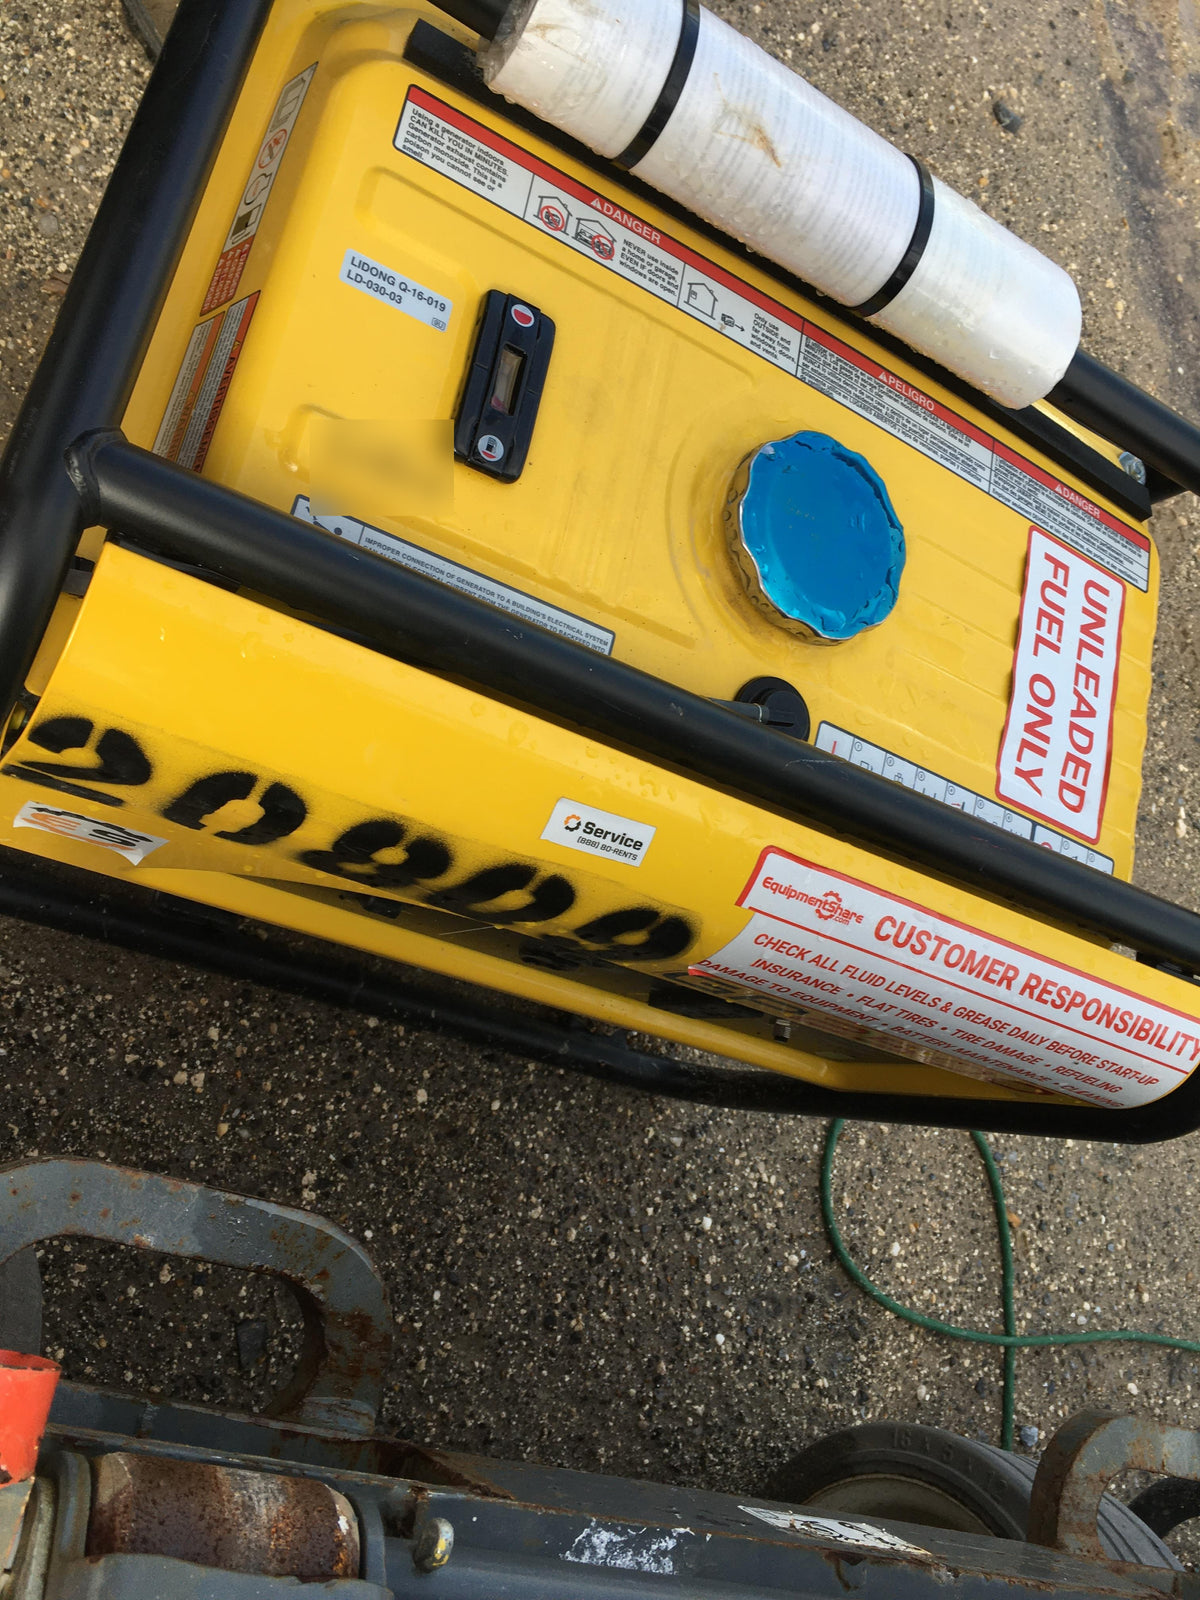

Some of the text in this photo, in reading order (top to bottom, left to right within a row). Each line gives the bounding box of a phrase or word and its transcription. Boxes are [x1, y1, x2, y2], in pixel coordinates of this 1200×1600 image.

[405, 129, 432, 148] carbon
[472, 166, 488, 180] This
[408, 122, 506, 182] Generator exhaust contains
[410, 114, 427, 129] CAN
[428, 125, 445, 139] KILL
[447, 136, 463, 150] YOU
[411, 108, 433, 125] Using
[441, 125, 475, 150] generator
[477, 146, 504, 166] indoors
[403, 136, 430, 155] poison
[430, 152, 444, 164] you
[446, 160, 471, 178] cannot
[472, 176, 485, 186] see
[602, 201, 662, 244] DANGER
[623, 238, 646, 256] NEVER
[620, 252, 638, 267] EVEN
[647, 268, 665, 282] doors
[666, 279, 678, 290] and
[627, 248, 645, 263] home
[346, 269, 403, 304] LD-030-03
[350, 255, 447, 312] LIDONG Q-16-019
[886, 375, 936, 411] PELIGRO
[1061, 486, 1101, 519] DANGER
[365, 537, 400, 556] IMPROPER
[401, 553, 445, 576] CONNECTION
[456, 576, 496, 598] GENERATOR
[547, 616, 584, 637] ELECTRICAL
[584, 632, 609, 647] SYSTEM
[1014, 551, 1071, 798] FUEL ONLY
[1057, 579, 1110, 814] UNLEADED
[577, 836, 600, 849] (888)
[582, 821, 643, 851] Service
[762, 876, 864, 924] EquipmentShare
[697, 959, 770, 986] DAMAGE
[770, 982, 792, 994] TO
[789, 991, 880, 1024] EQUIPMENT
[753, 932, 1160, 1087] CHECK ALL FLUID LEVELS & GREASE DAILY BEFORE START-UP
[874, 915, 1200, 1062] CUSTOMER RESPONSIBILITY
[750, 958, 845, 996] INSURANCE
[856, 995, 899, 1014] FLAT
[900, 1008, 938, 1029] TIRES
[951, 1028, 985, 1044] TIRE
[981, 1039, 1044, 1067] DAMAGE
[1051, 1065, 1123, 1095] REFUELING
